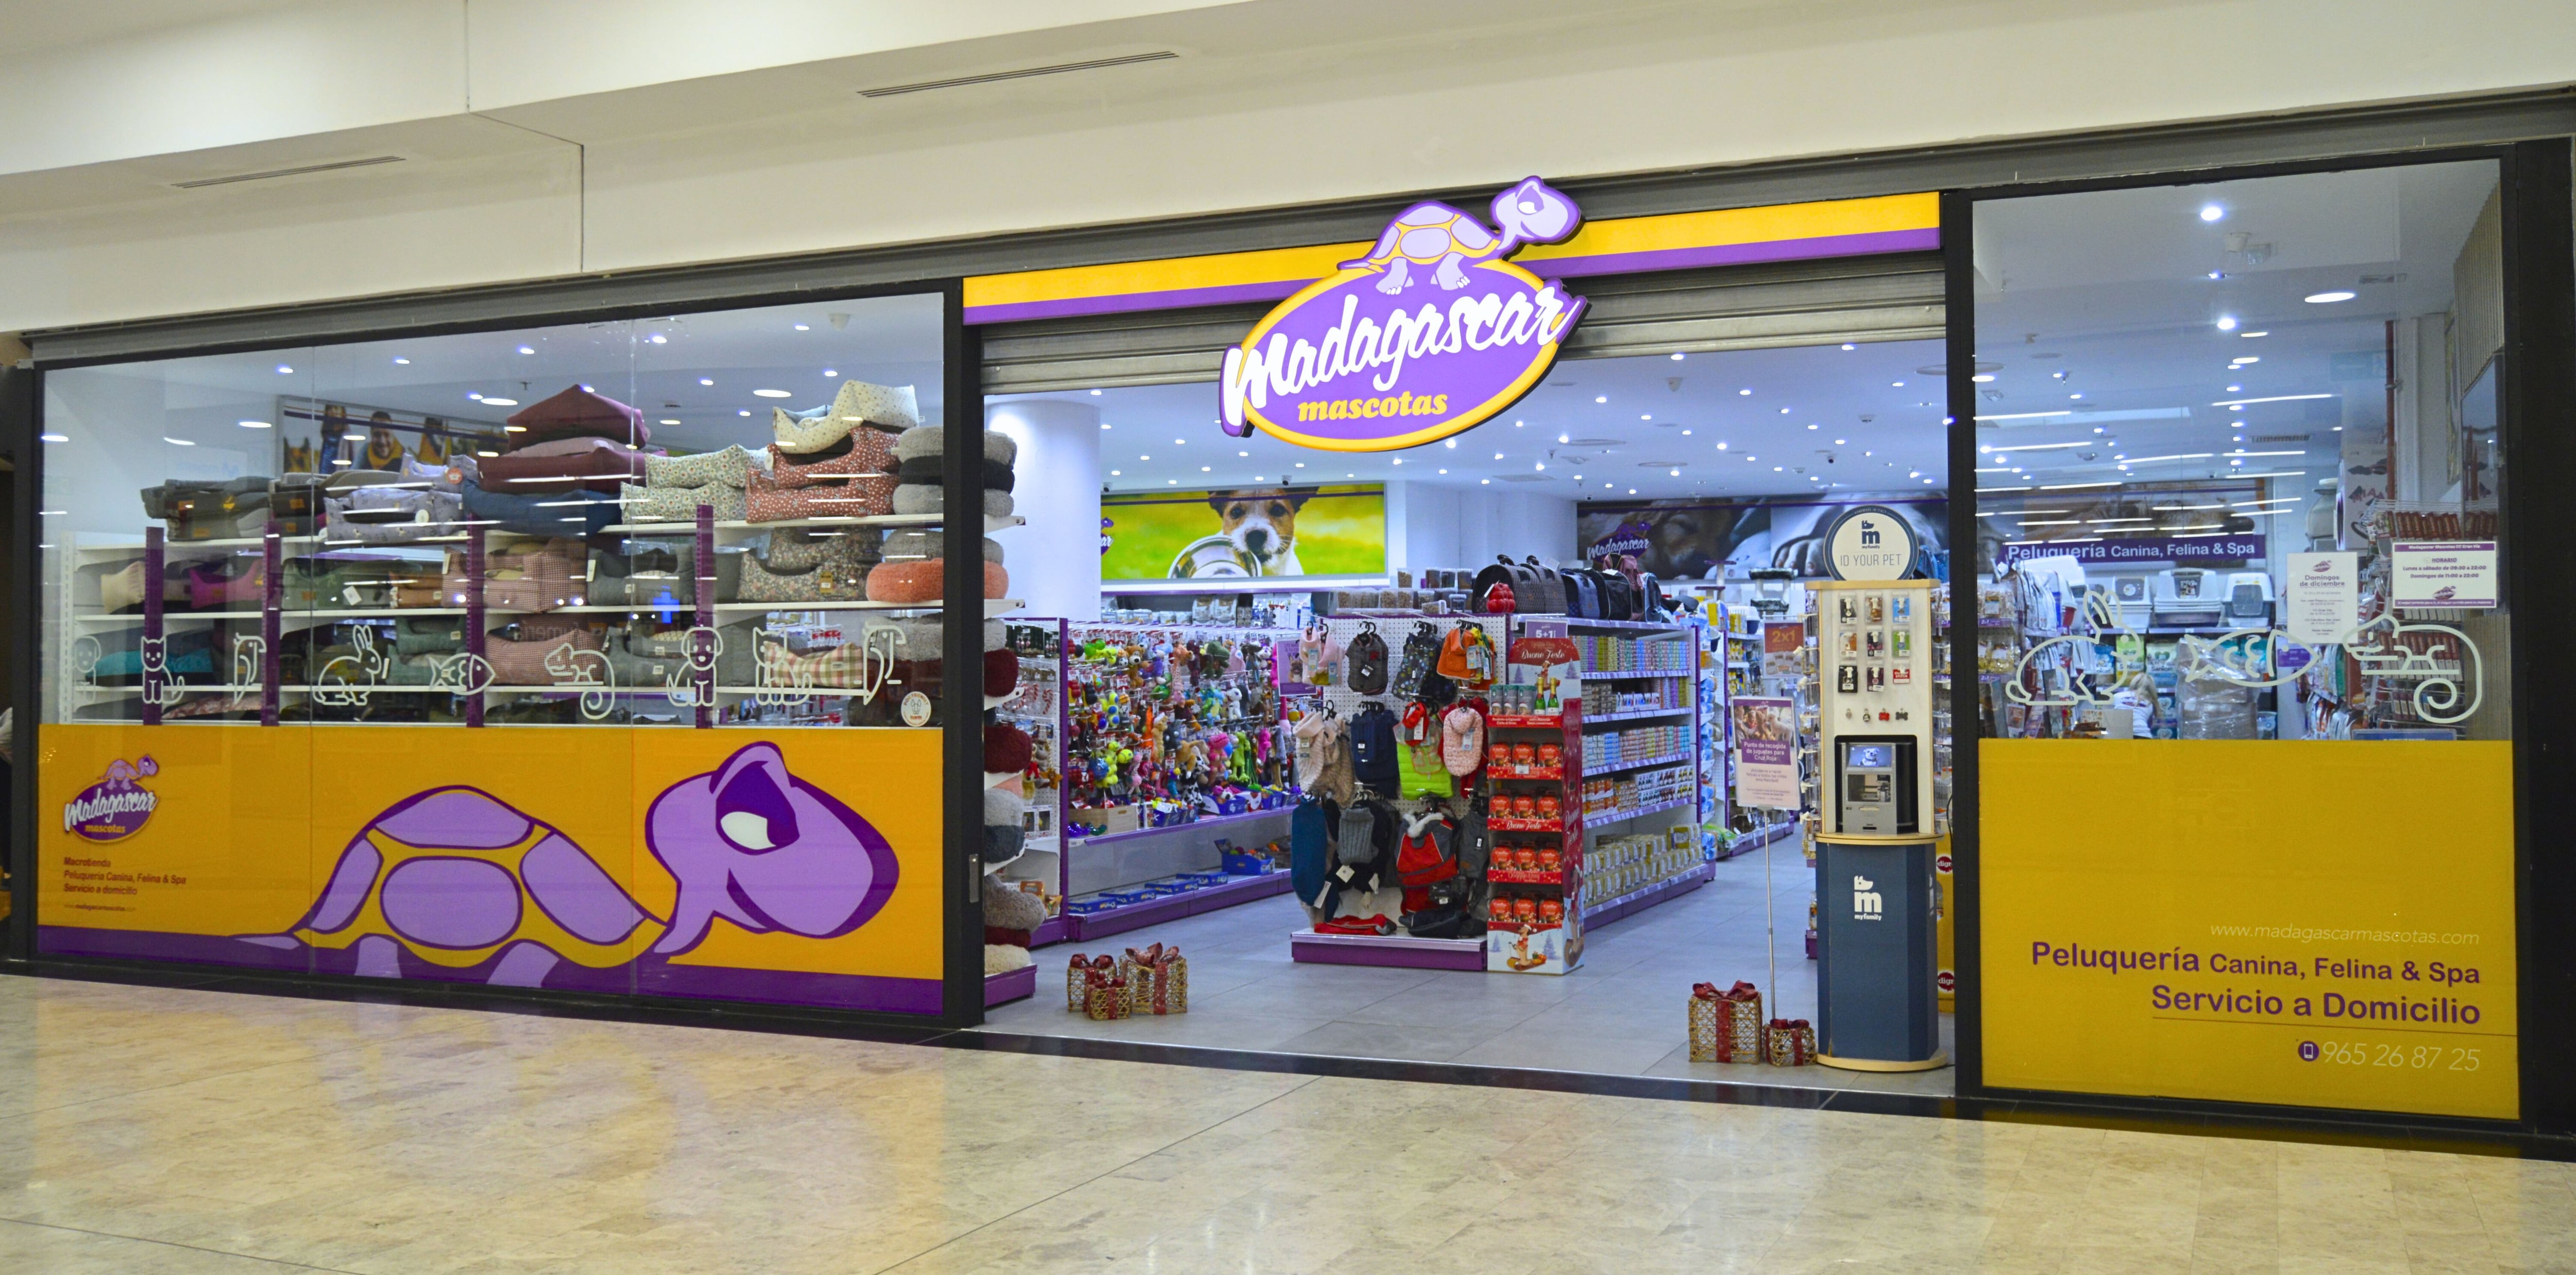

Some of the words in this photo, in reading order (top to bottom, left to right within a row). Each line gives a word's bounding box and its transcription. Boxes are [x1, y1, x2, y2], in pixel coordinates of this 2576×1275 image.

[1224, 286, 1587, 427] Madagascar
[1298, 390, 1448, 422] mascotas
[1587, 538, 1652, 560] Madagascar
[2008, 542, 2106, 559] Peluquería
[2111, 545, 2164, 558] Canina,
[2167, 543, 2209, 556] Felina
[2213, 542, 2224, 555] &
[2227, 542, 2255, 558] Spa
[1840, 555, 1850, 567] ID
[1853, 554, 1879, 566] YOUR
[1883, 554, 1901, 566] PET
[1772, 630, 1795, 643] 2x1
[64, 788, 159, 831] Madagascar
[84, 823, 126, 835] mascotas
[64, 857, 111, 868] Macrotienda
[64, 883, 95, 893] Servicio
[103, 885, 138, 895] domicilio
[106, 872, 135, 883] Canina,
[137, 873, 161, 883] Felina
[162, 875, 168, 883] &
[171, 875, 187, 886] Spa
[2210, 922, 2480, 945] www.madagascarmascotas.com
[2031, 941, 2199, 973] Peluquería
[2210, 953, 2307, 980] Canina,
[2315, 957, 2392, 980] Felina
[2401, 961, 2420, 982] &
[2429, 962, 2480, 987] Spa
[2153, 984, 2283, 1015] Servicio
[2293, 996, 2312, 1016] a
[2324, 992, 2480, 1025] Domicilio
[2323, 1040, 2366, 1065] 965
[2373, 1043, 2403, 1067] 26
[2412, 1045, 2442, 1069] 87
[2450, 1047, 2480, 1072] 25
